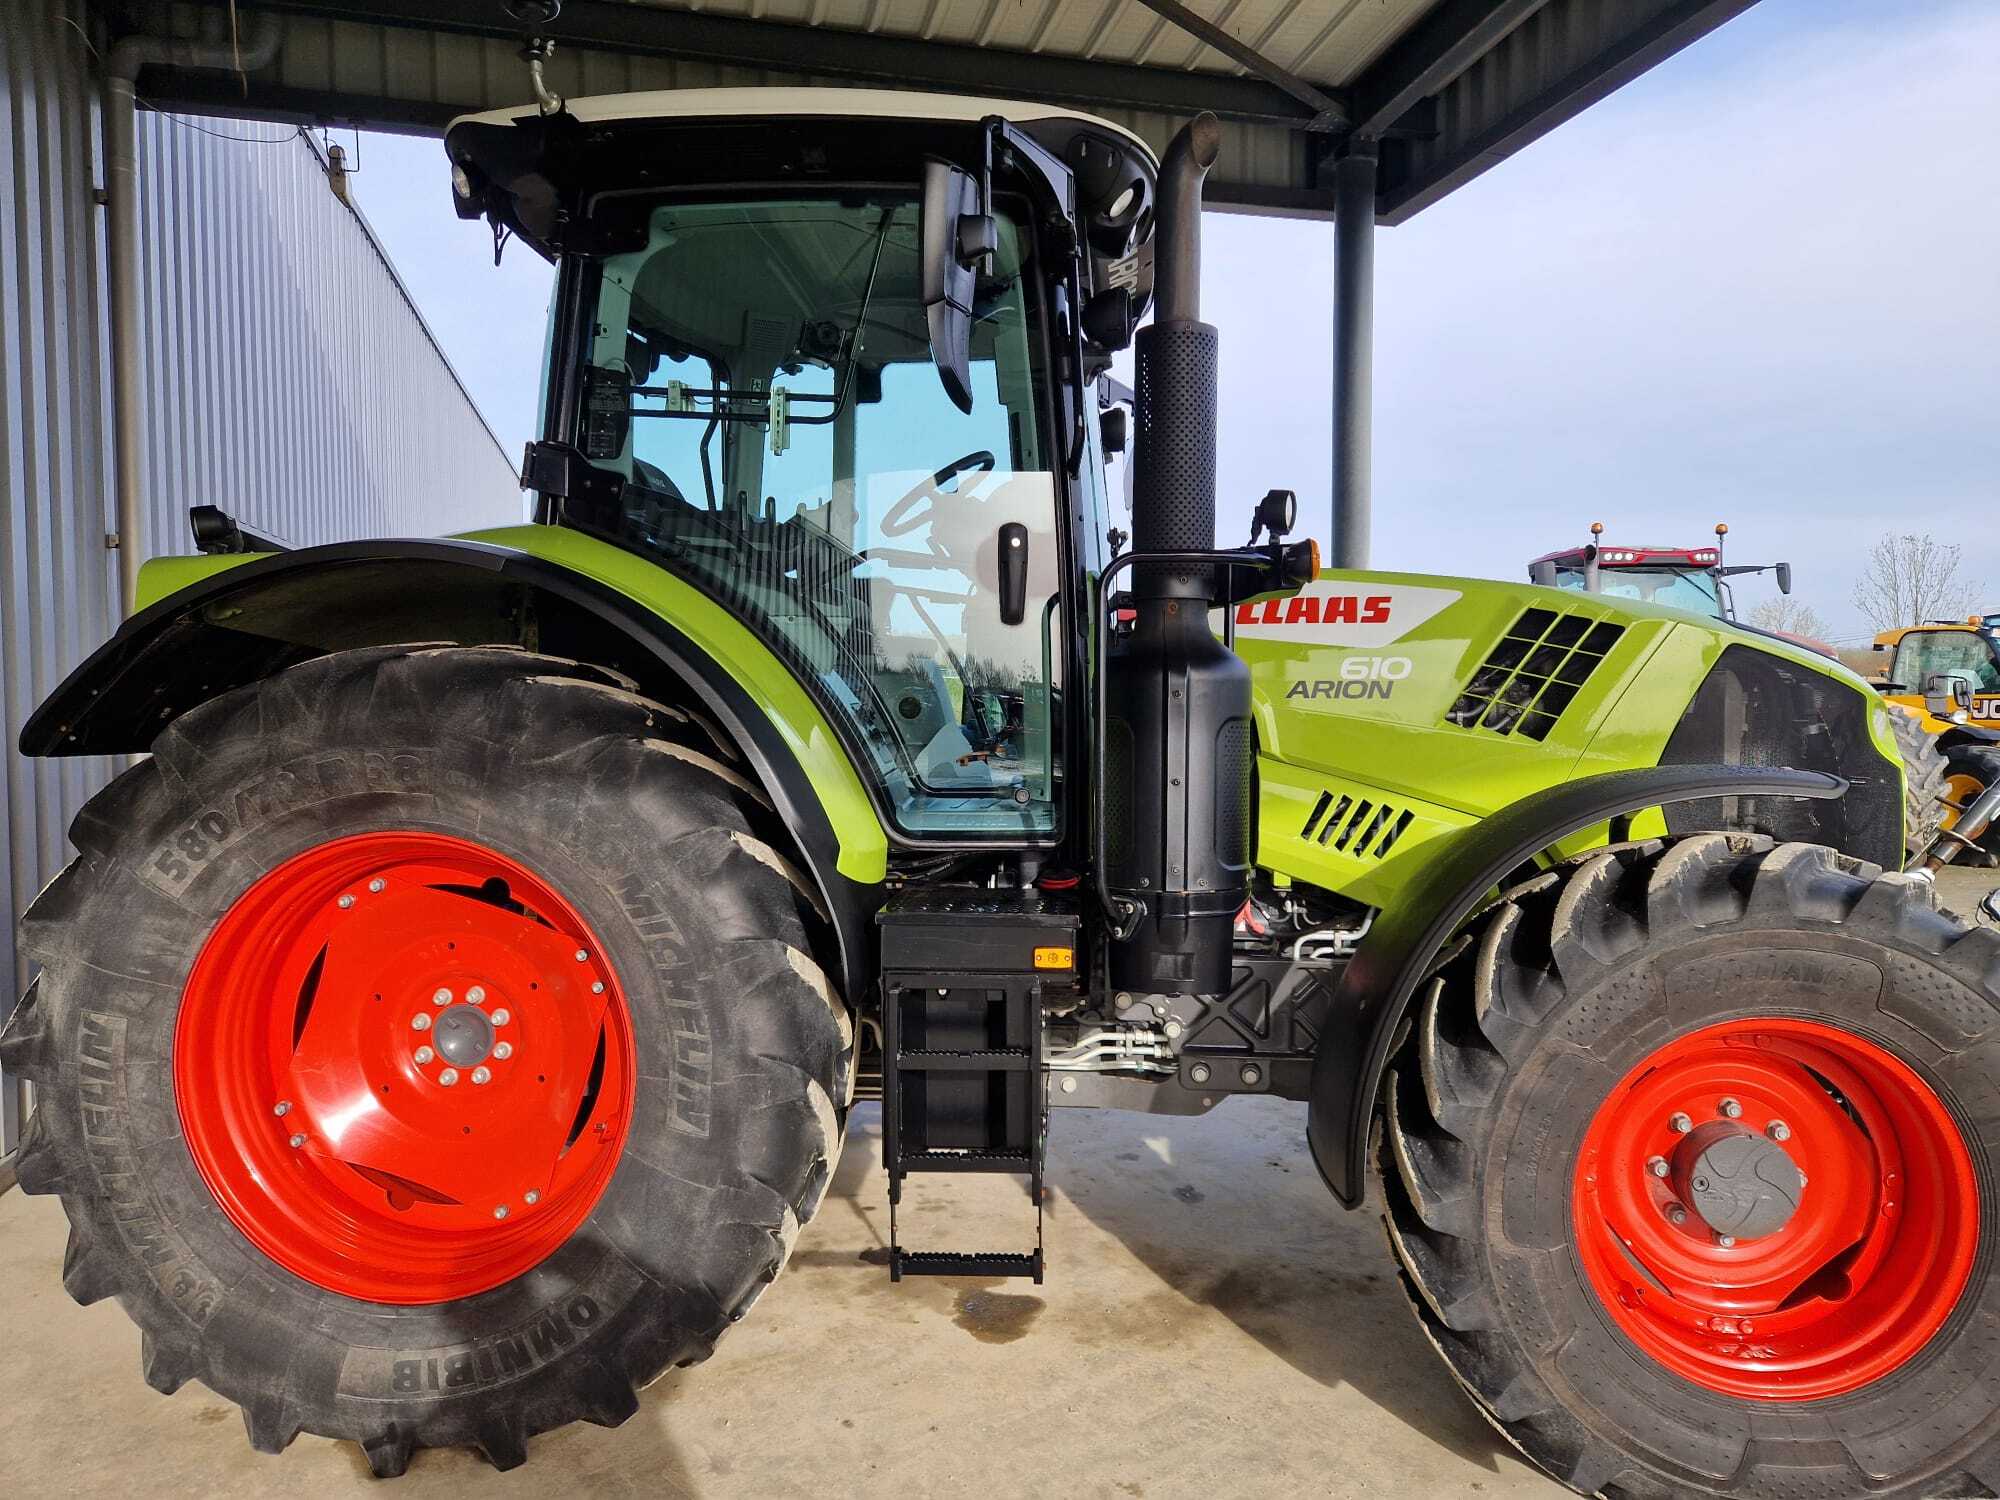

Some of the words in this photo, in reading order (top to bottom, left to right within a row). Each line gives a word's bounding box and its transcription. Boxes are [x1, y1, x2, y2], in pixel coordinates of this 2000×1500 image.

[1236, 597, 1392, 624] CLAAS
[1286, 680, 1393, 699] ARION
[1340, 656, 1412, 680] 610
[612, 871, 711, 1132] MICHELIN
[79, 1017, 175, 1267] MICHELIN
[393, 1294, 599, 1393] OMNIBIB
